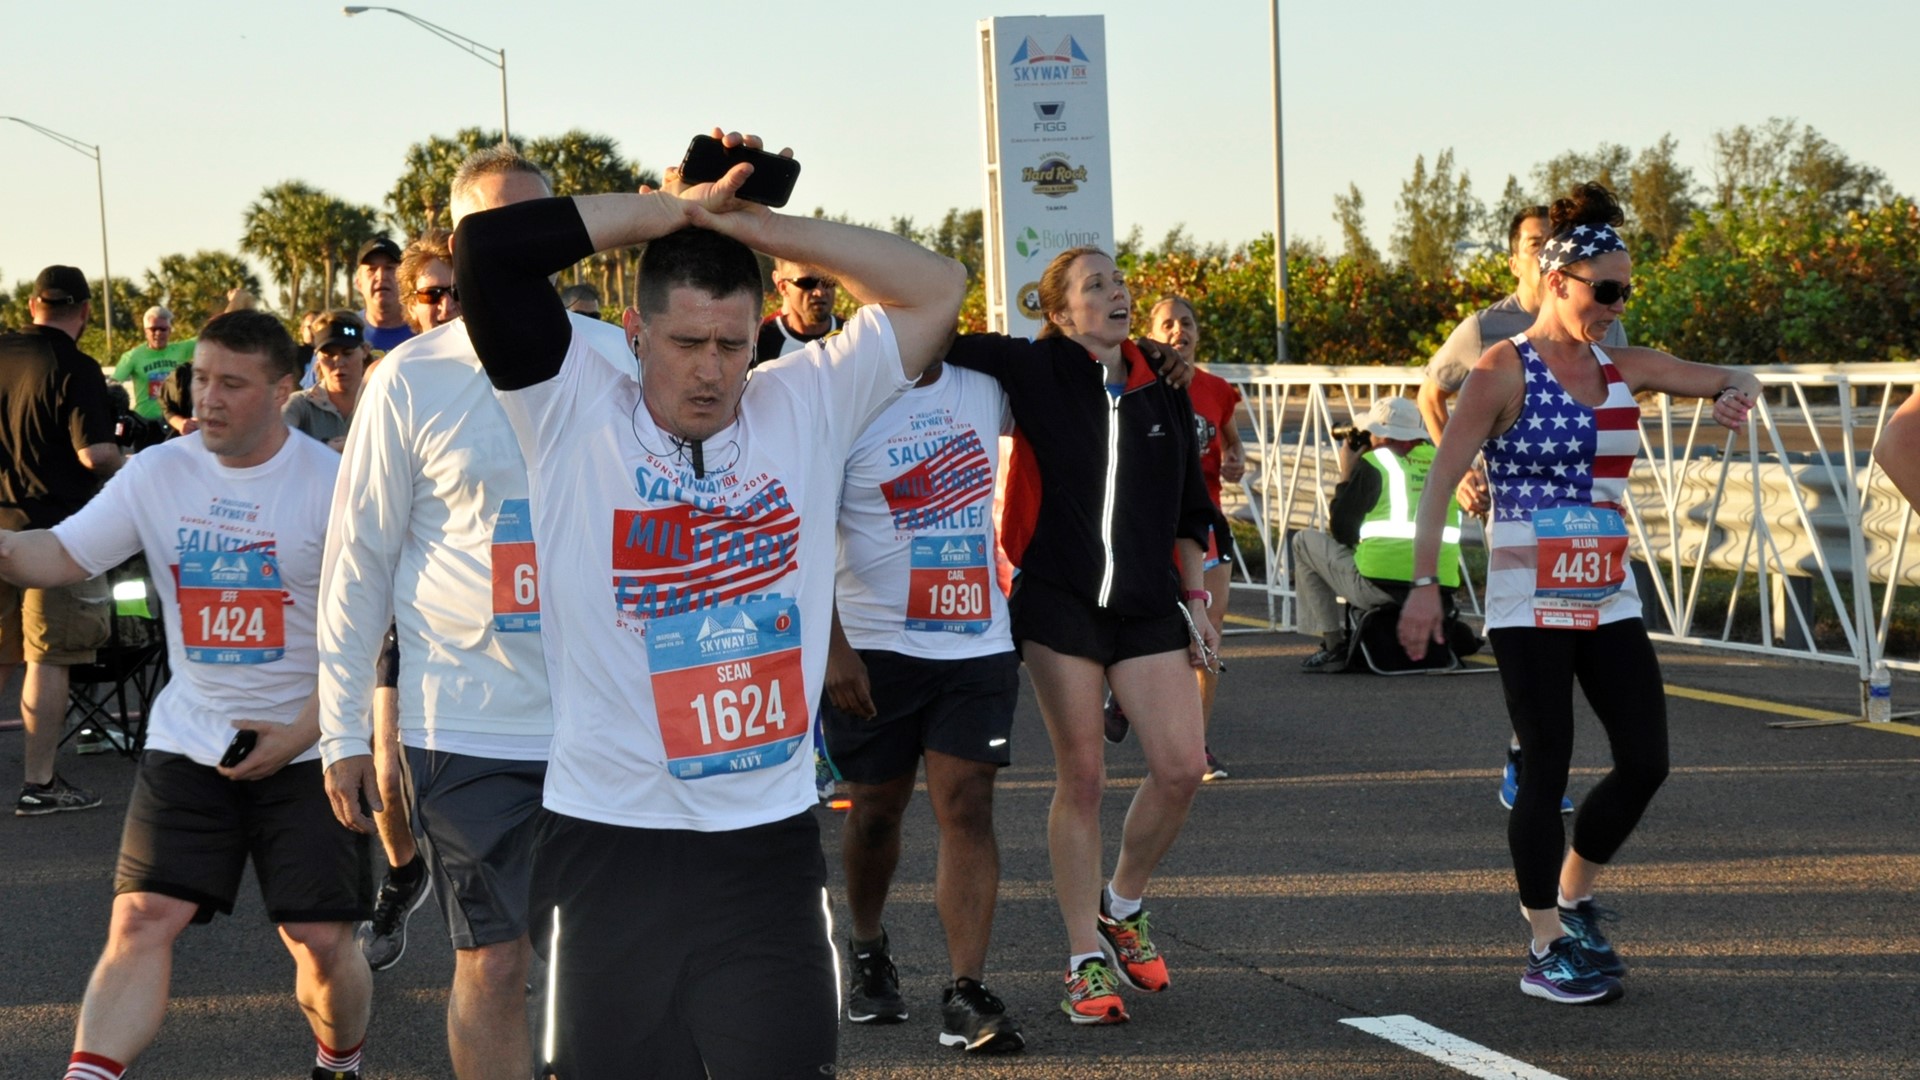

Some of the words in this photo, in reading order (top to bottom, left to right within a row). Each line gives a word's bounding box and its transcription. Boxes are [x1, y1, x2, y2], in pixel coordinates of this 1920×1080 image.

[1014, 65, 1069, 81] SKYWAY
[1072, 67, 1087, 77] 10K
[1033, 121, 1067, 133] FIGG
[1023, 166, 1056, 183] Hard
[1056, 164, 1088, 183] Rock
[1043, 228, 1100, 250] BioSpine
[911, 416, 943, 431] SKYWAY
[887, 431, 983, 468] SALUTING
[743, 472, 769, 492] 2018
[893, 466, 986, 499] MILITARY
[894, 505, 985, 531] FAMILIES
[1564, 523, 1591, 532] SKYWAY
[625, 514, 794, 569] MILITARY
[1572, 538, 1599, 549] JILLIAN
[947, 570, 966, 581] CARL
[1552, 551, 1612, 584] 4431
[220, 590, 239, 603] JEFF
[928, 583, 983, 616] 1930
[199, 606, 266, 643] 1424
[700, 634, 746, 654] SKYWAY
[717, 661, 752, 684] SEAN
[690, 679, 786, 746] 1624
[729, 754, 762, 771] NAVY
